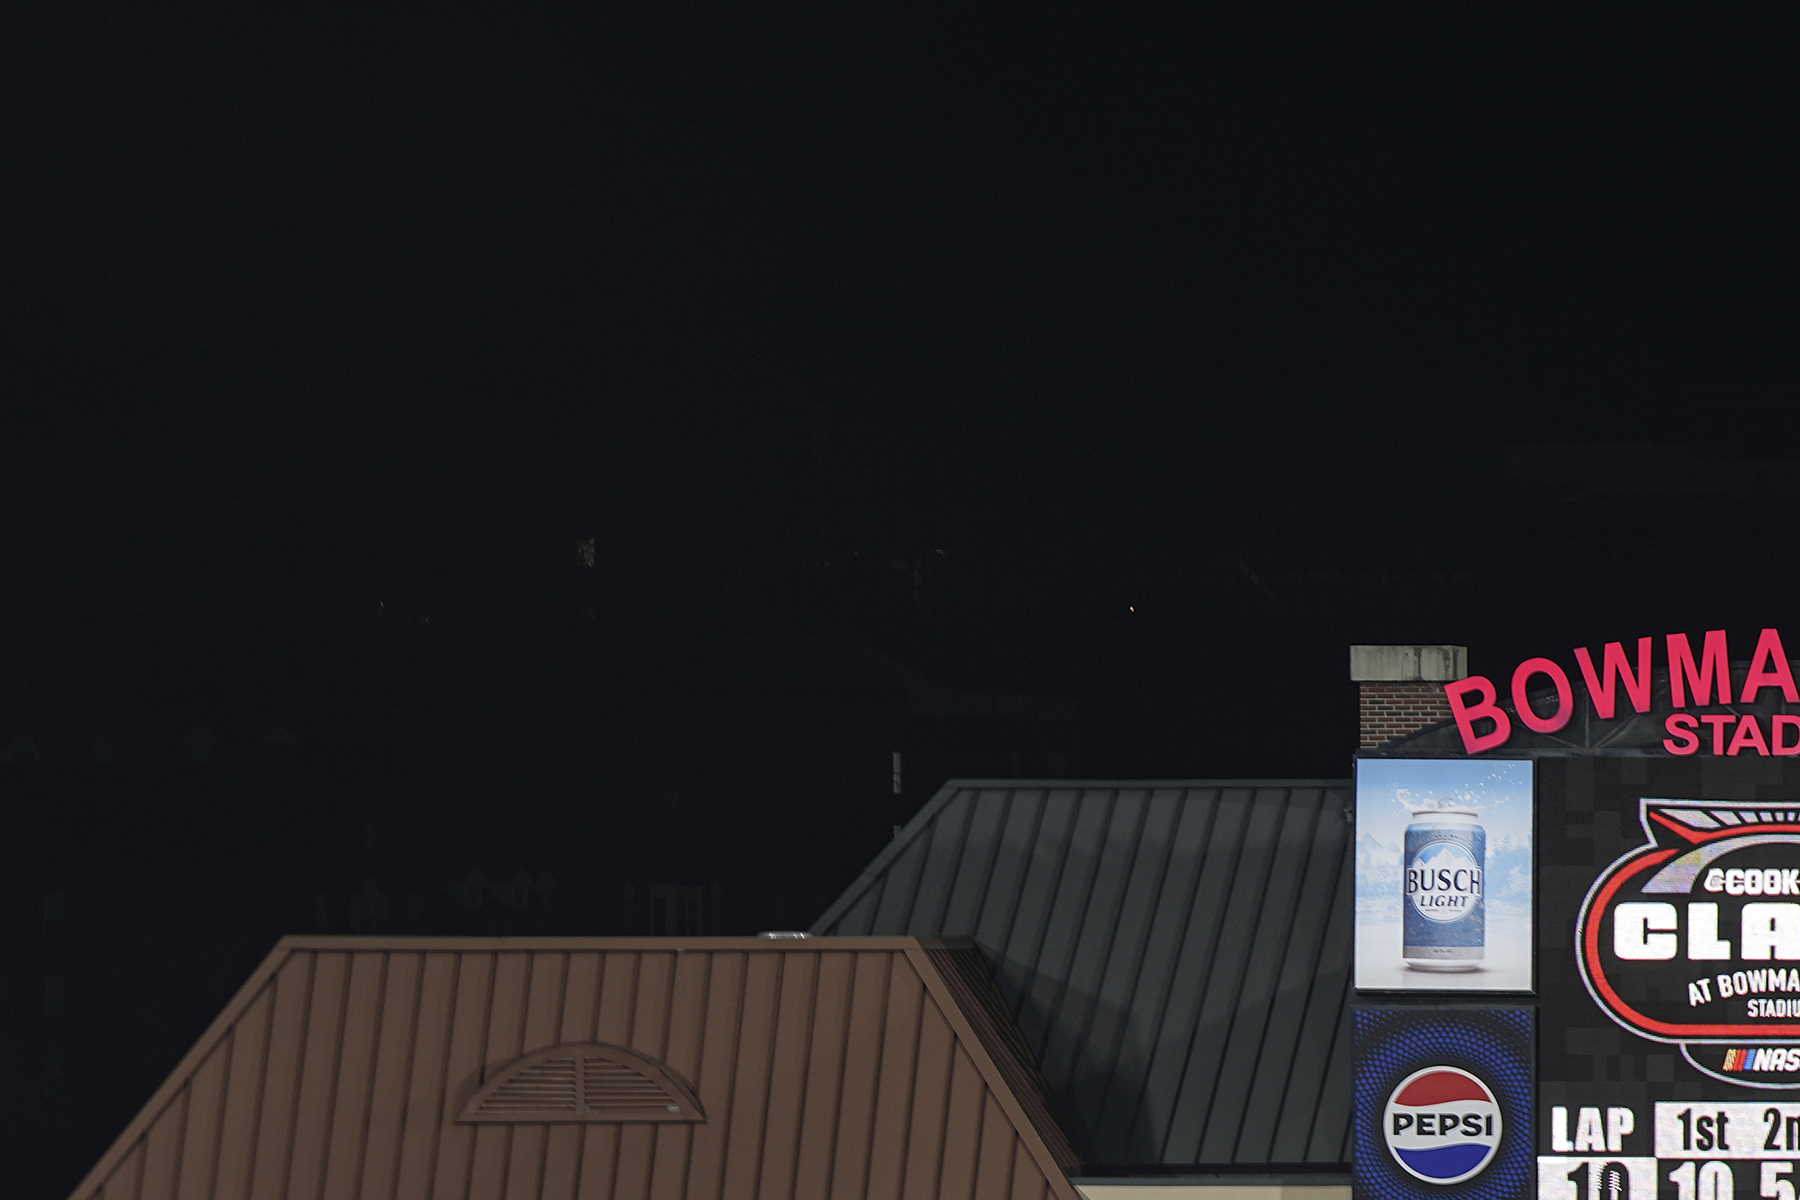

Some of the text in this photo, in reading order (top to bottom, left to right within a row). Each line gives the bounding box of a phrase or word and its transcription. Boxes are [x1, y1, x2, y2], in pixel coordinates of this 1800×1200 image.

[1406, 868, 1483, 896] BUSCH
[1724, 868, 1800, 895] COOK
[1419, 895, 1470, 908] LIGHT
[1688, 979, 1711, 1006] AT
[1392, 1113, 1493, 1138] PEPSI
[1551, 1107, 1635, 1152] LAP
[1677, 1108, 1729, 1151] 1st
